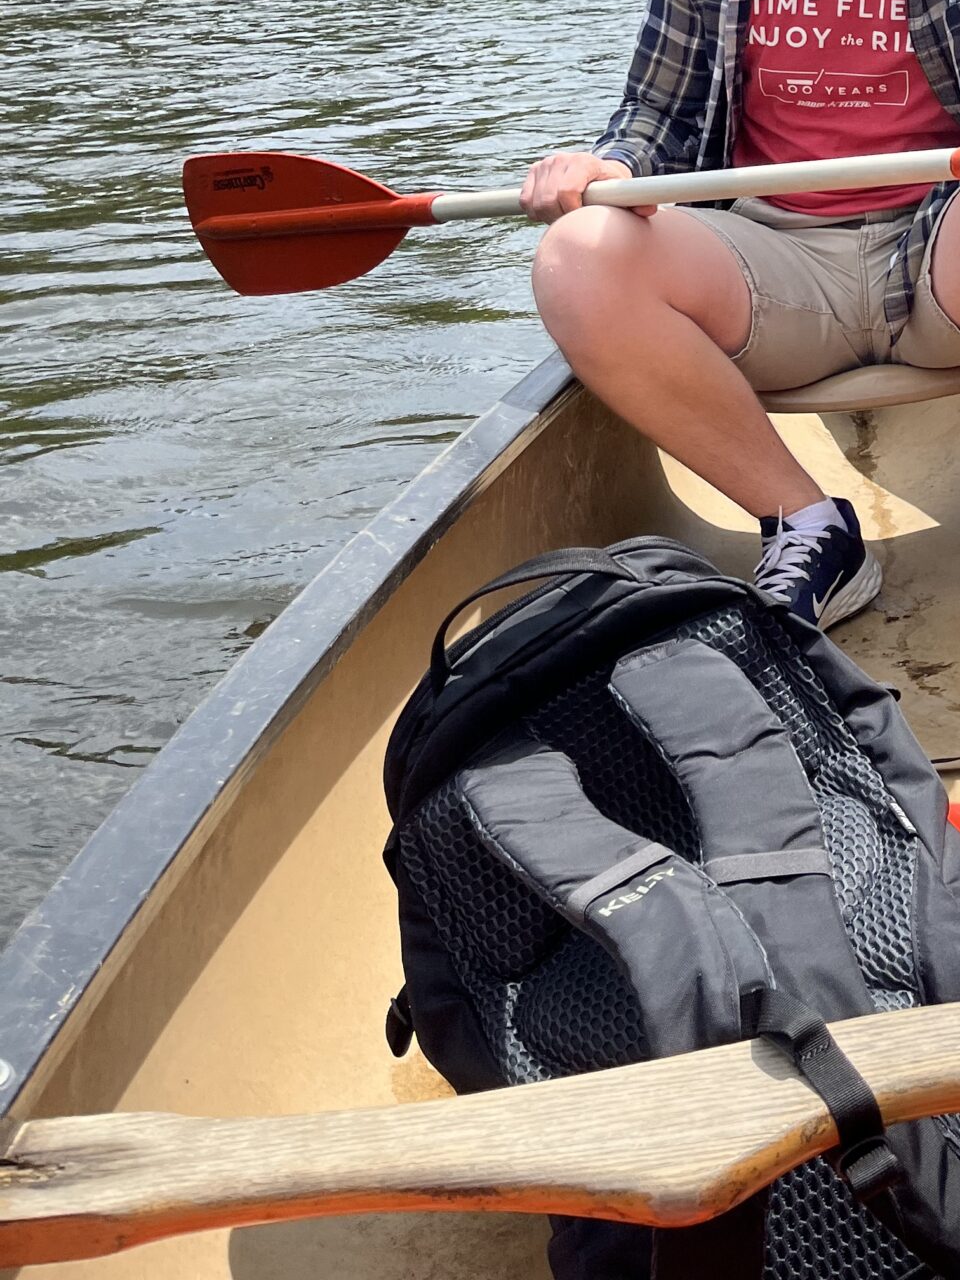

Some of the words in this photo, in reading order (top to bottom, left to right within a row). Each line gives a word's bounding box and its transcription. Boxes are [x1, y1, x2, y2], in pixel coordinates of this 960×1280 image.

[748, 24, 832, 49] NJOY
[840, 33, 864, 47] the
[778, 84, 813, 95] 100
[825, 83, 888, 96] YEARS
[598, 867, 675, 917] KELTY
